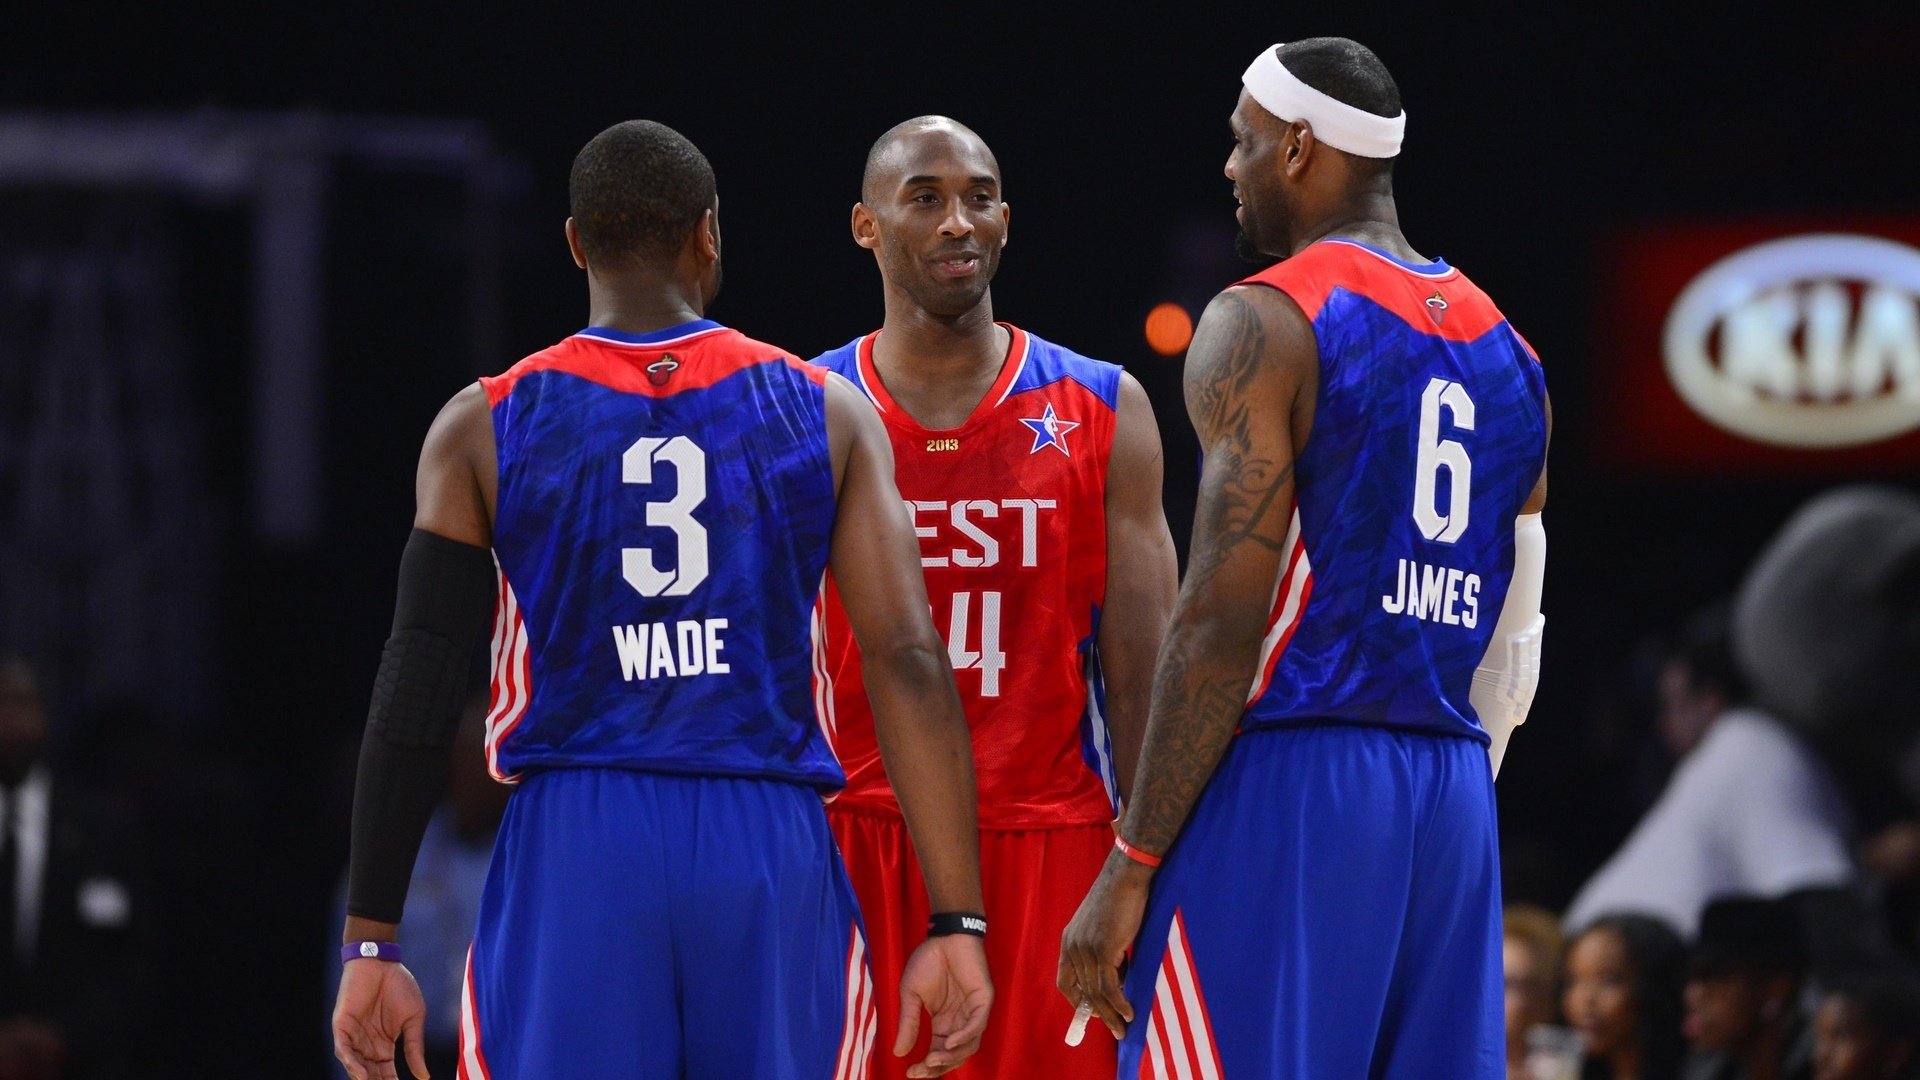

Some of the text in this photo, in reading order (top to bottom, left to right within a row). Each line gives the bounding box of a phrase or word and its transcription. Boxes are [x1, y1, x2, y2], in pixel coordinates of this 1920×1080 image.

[1723, 282, 1920, 400] KIA
[926, 438, 959, 452] 2013
[1412, 377, 1475, 544] 6
[621, 435, 709, 597] 3
[902, 499, 1057, 568] EST
[1382, 558, 1481, 629] JAMES
[612, 618, 730, 681] WADE
[929, 591, 1006, 697] 4
